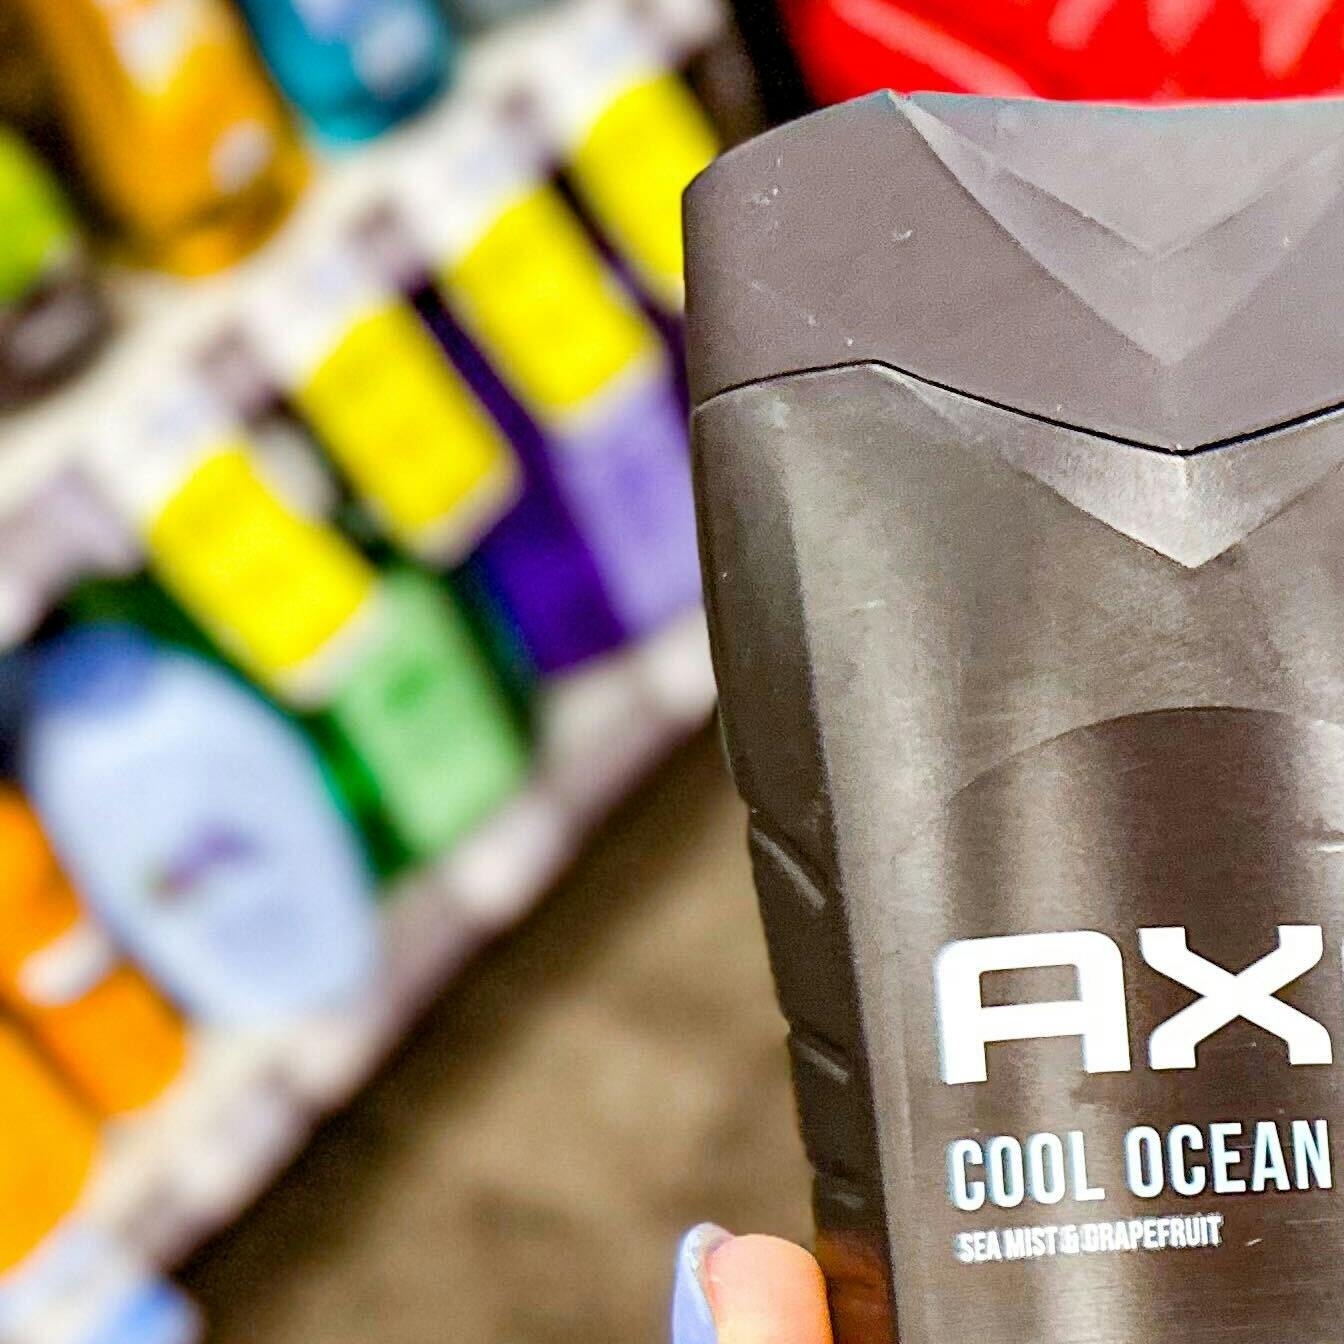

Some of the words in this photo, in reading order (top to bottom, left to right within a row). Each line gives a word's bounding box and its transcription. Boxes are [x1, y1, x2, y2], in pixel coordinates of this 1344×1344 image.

[947, 1130, 1106, 1211] COOL
[1124, 1119, 1333, 1198] OCEAN
[956, 1228, 1001, 1263] SEA
[1003, 1225, 1058, 1258] MIST
[1081, 1213, 1224, 1252] GRAPEFRUIT
